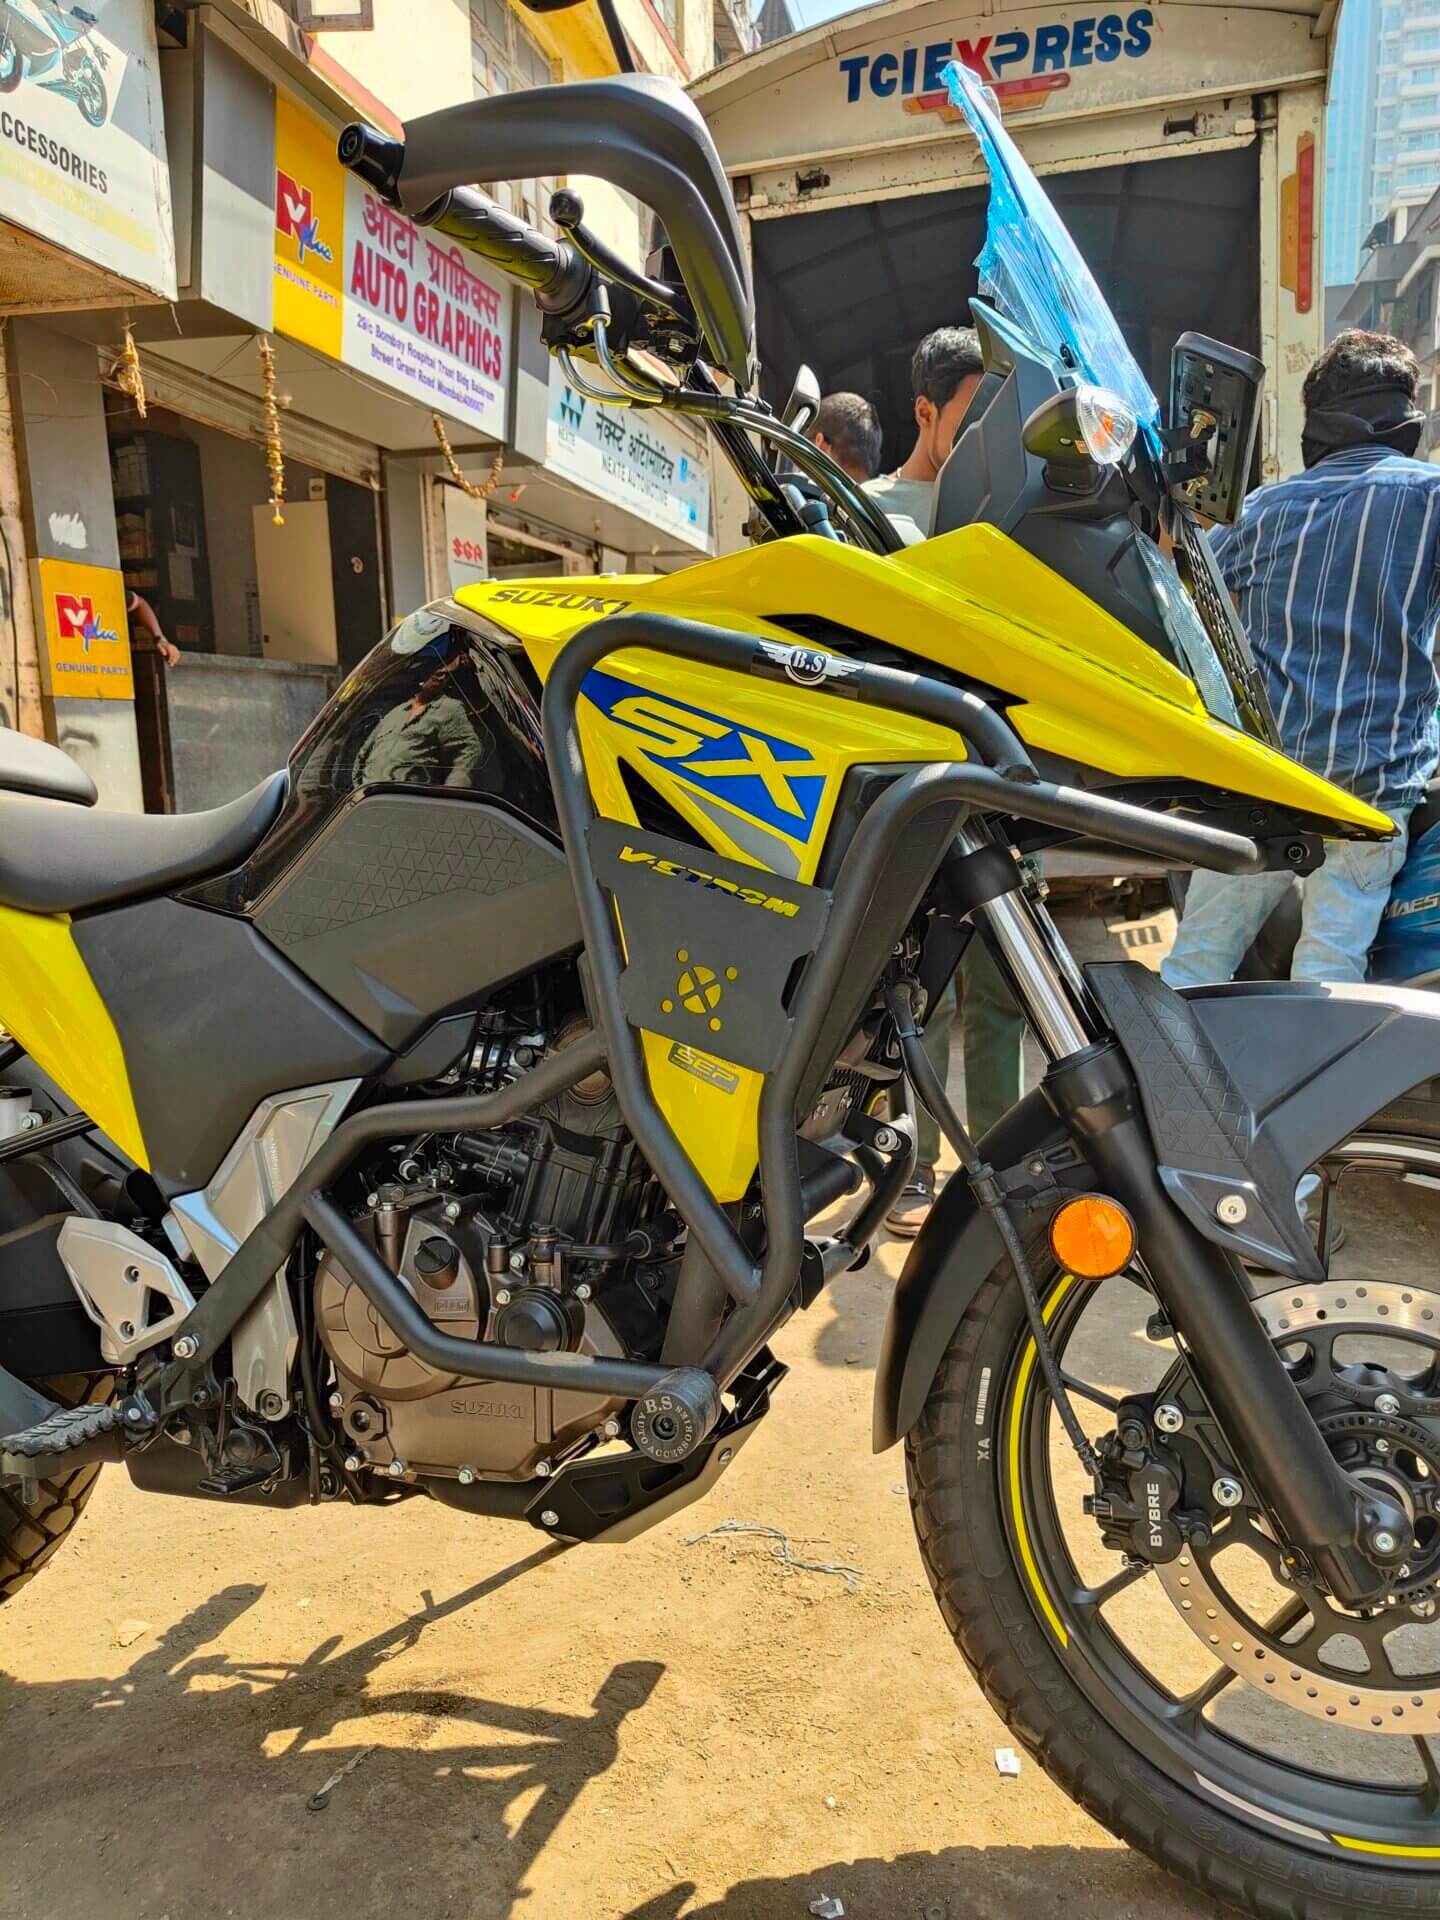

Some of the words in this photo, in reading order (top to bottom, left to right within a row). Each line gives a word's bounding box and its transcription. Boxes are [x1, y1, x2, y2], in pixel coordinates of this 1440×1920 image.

[0, 111, 108, 194] CCESSORIES
[351, 240, 408, 323] AUTO
[414, 281, 502, 381] GRAPHICS
[489, 589, 632, 615] SUZUKI
[56, 662, 97, 674] GENUINE
[100, 665, 129, 675] PARTS
[609, 696, 827, 820] SX
[1385, 892, 1440, 920] MAES
[450, 1400, 524, 1419] SUZUKI
[645, 1395, 673, 1413] B.S
[637, 1412, 649, 1445] AUTO
[1147, 1483, 1162, 1547] BYBRE
